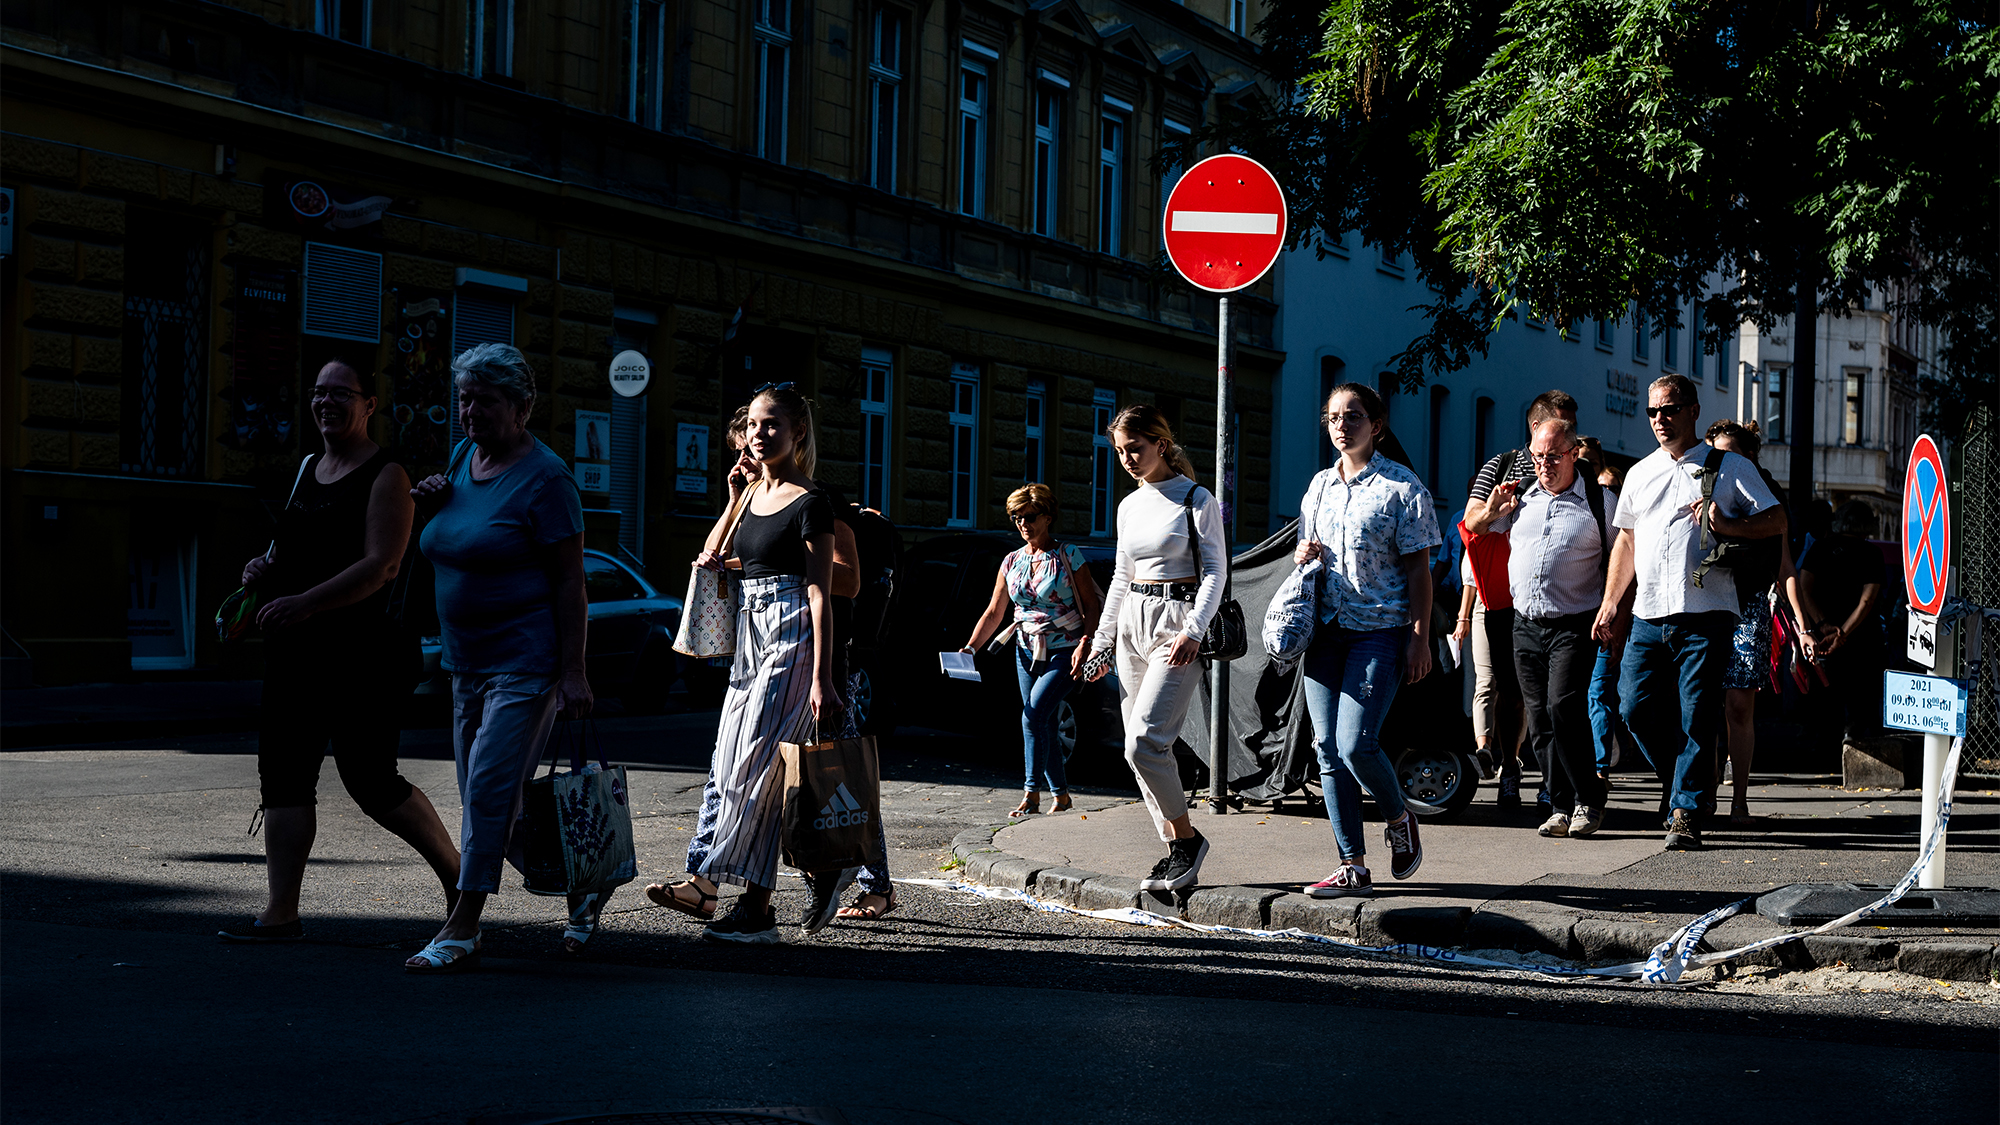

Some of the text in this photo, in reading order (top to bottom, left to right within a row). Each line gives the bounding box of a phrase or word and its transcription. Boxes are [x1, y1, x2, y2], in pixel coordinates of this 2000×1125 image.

[243, 287, 287, 303] ELVITELRE
[584, 472, 601, 484] SHOP
[1910, 679, 1931, 692] 2021
[1891, 694, 1919, 708] 09.09.
[1892, 711, 1920, 726] 09.13.
[813, 809, 869, 831] adidas
